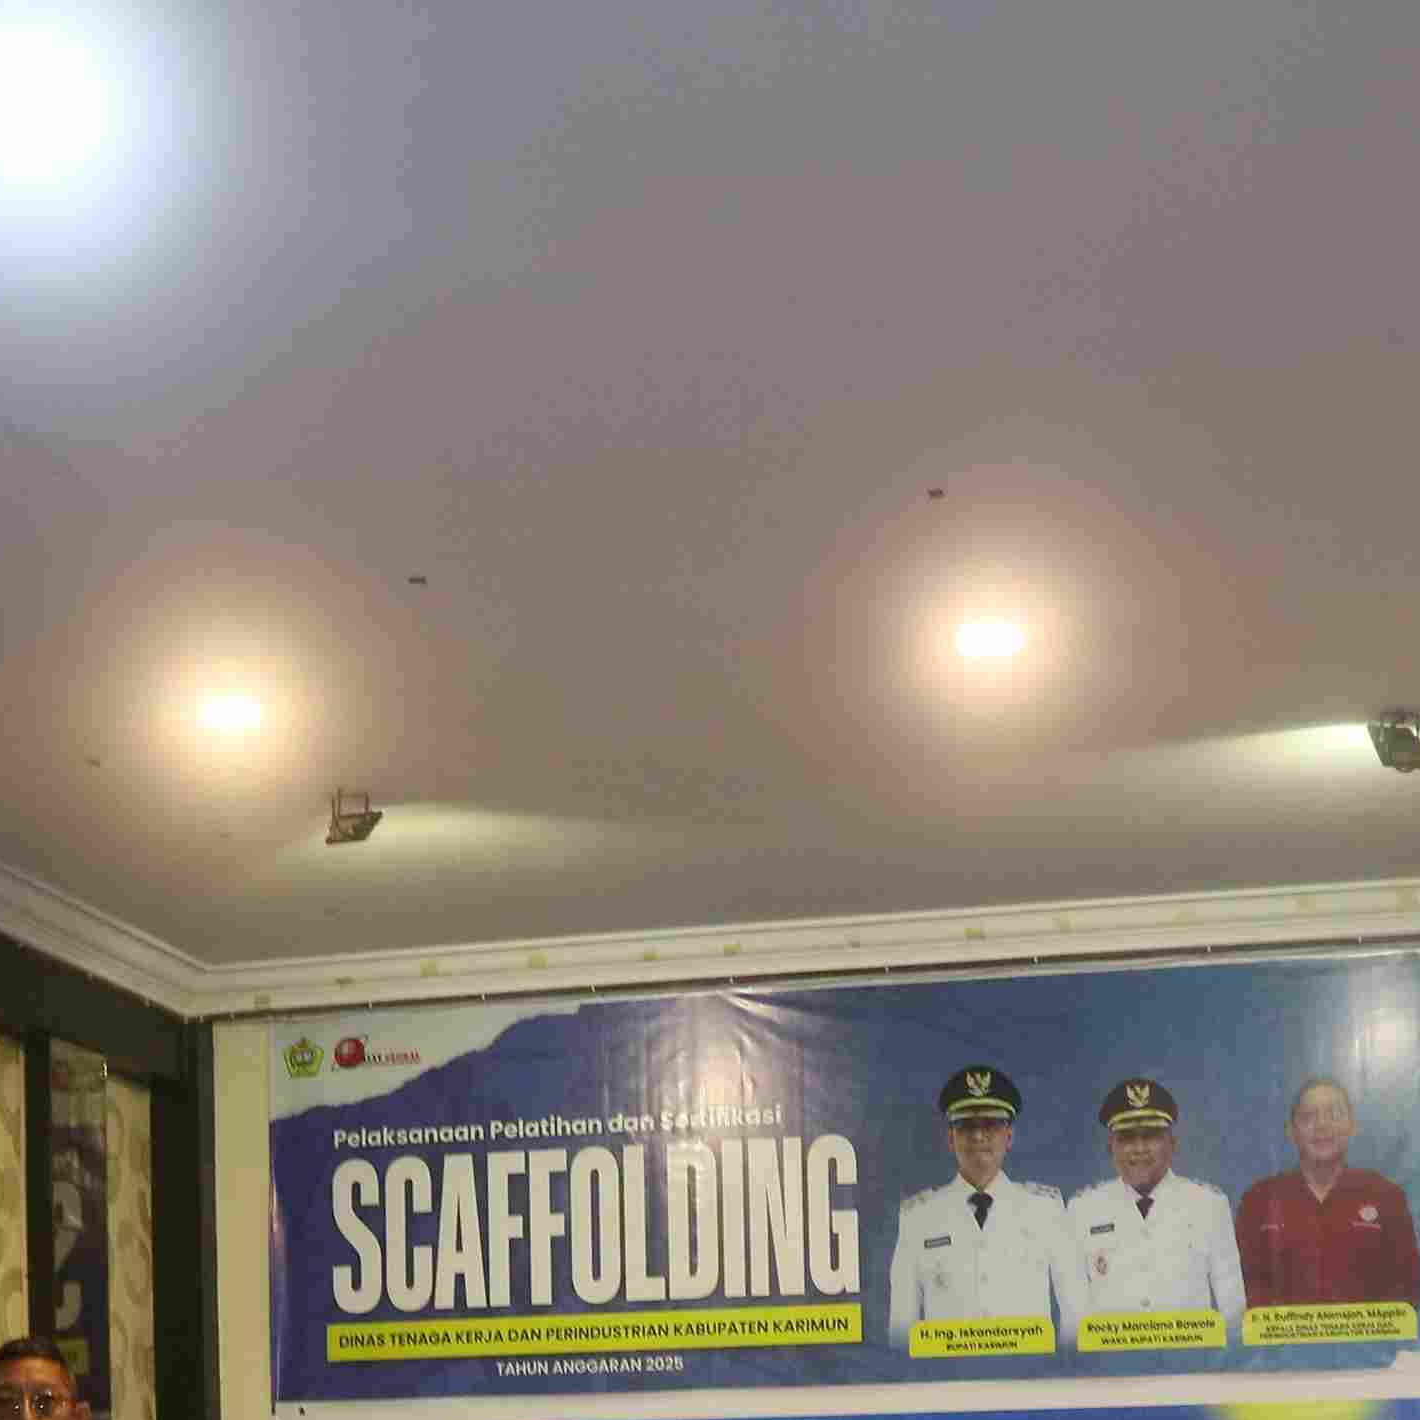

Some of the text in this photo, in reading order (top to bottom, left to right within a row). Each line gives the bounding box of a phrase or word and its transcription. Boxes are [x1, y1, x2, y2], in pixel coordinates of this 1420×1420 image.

[333, 1125, 485, 1150] Pelaksanaan
[490, 1116, 603, 1140] Pelatihan
[607, 1112, 655, 1133] dan
[331, 1134, 861, 1315] SCAFFOLDING
[339, 1317, 849, 1350] DINAS TENAGA KERJA DAN PERINDUSTRIAN KABUPATEN KARIMUN
[496, 1355, 685, 1377] TAHUN ANGGARAN 2025
